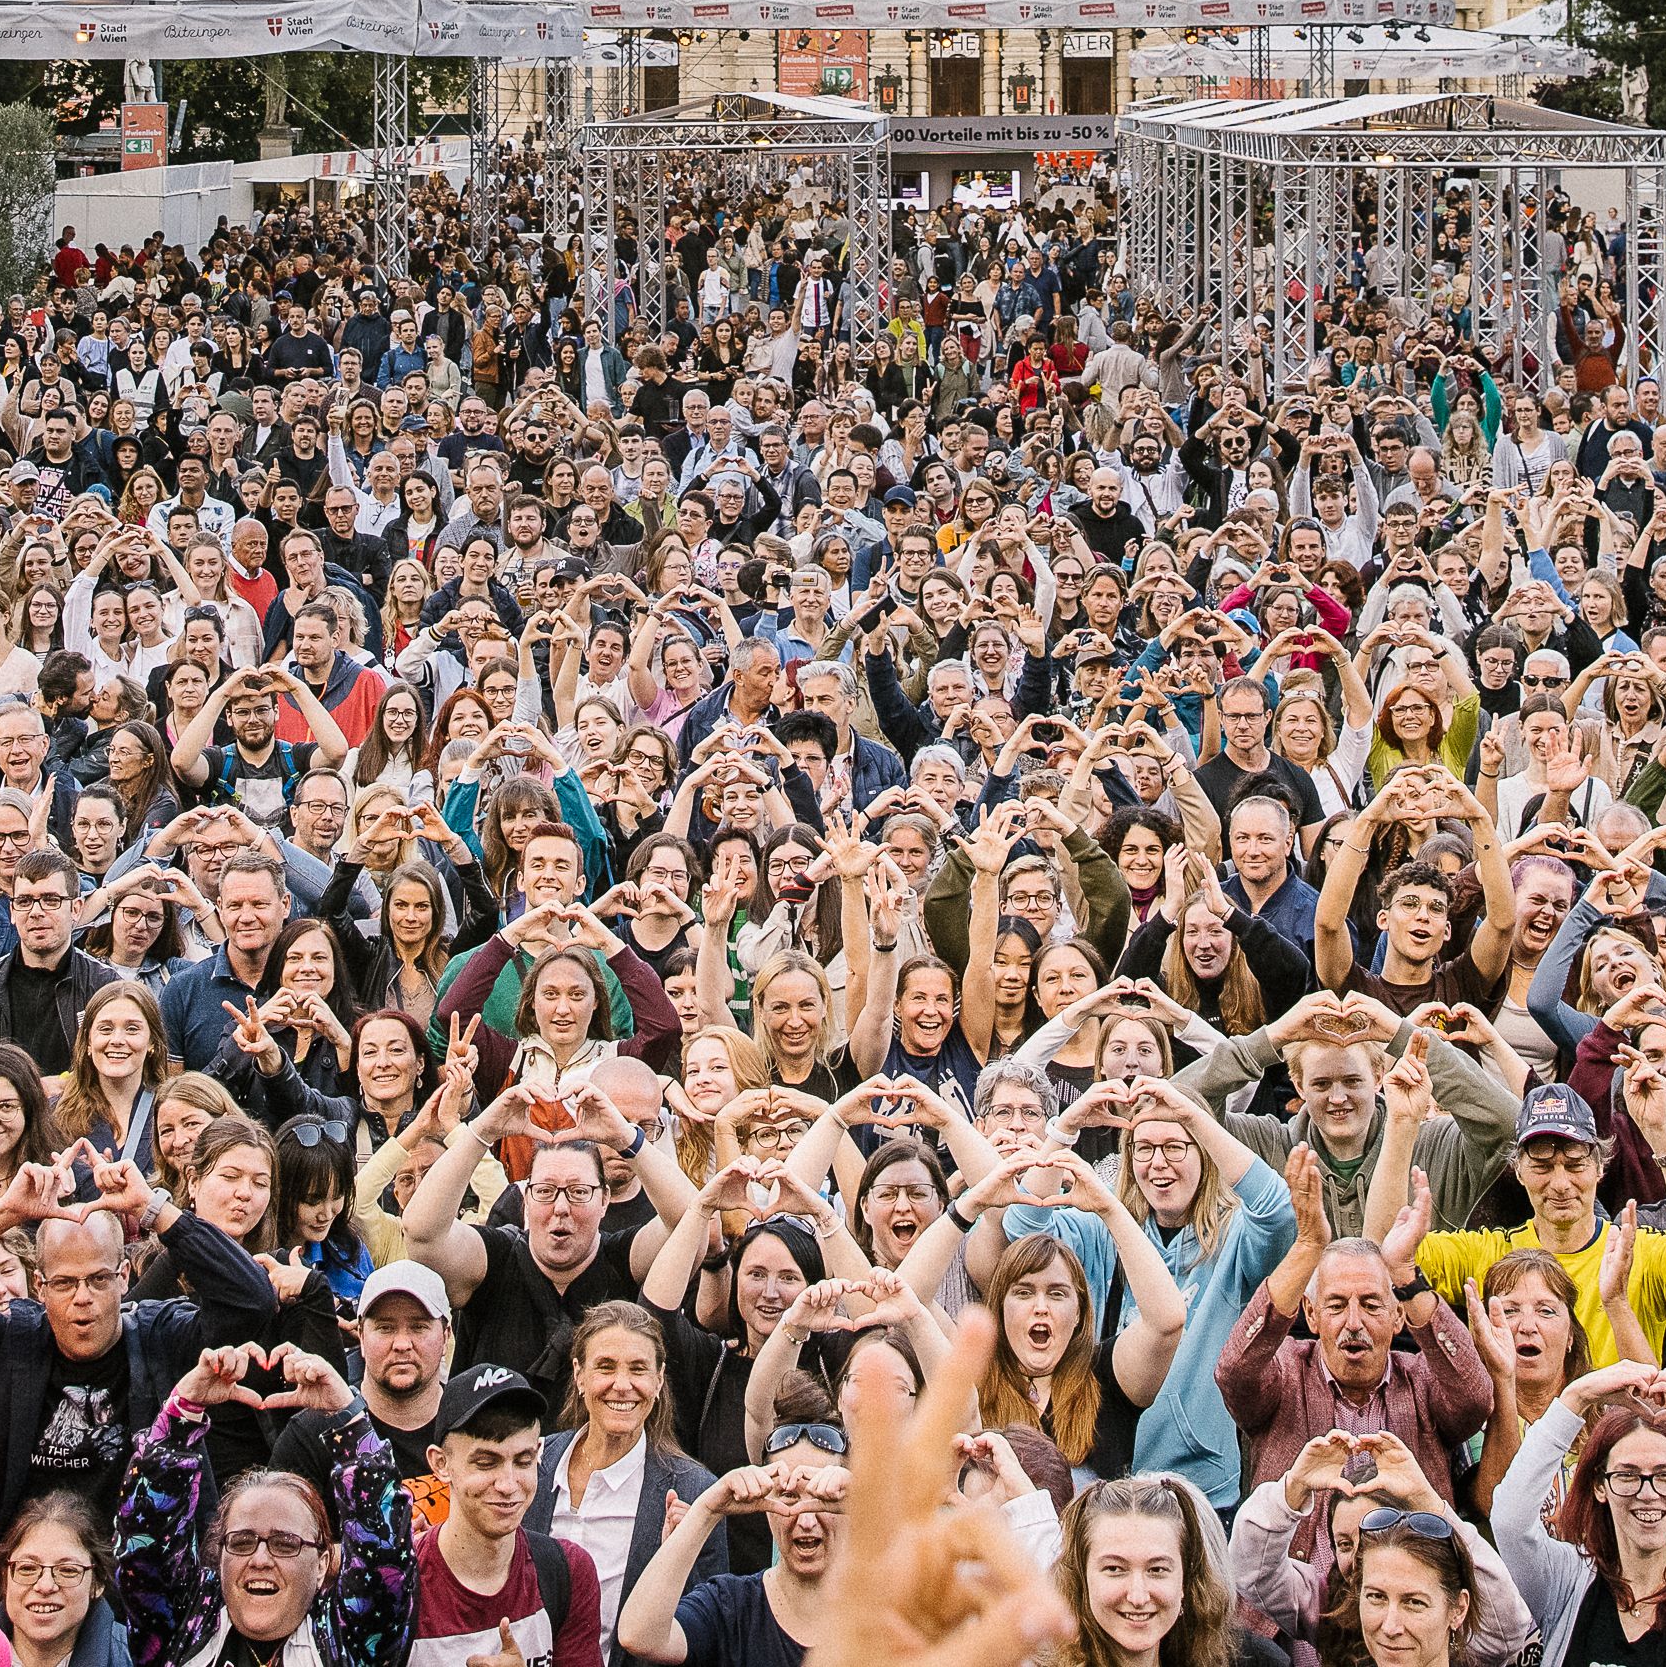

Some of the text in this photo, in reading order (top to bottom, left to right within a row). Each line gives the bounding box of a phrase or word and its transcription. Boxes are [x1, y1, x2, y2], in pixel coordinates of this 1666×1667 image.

[287, 16, 313, 26] Stadt
[347, 16, 405, 37] Bitzinger
[441, 22, 458, 30] Stadt
[100, 24, 127, 33] Stadt
[164, 25, 233, 42] Bitzinger
[287, 27, 314, 36] Wien
[100, 34, 127, 43] Wien
[1064, 36, 1111, 50] ATER
[919, 128, 982, 142] Vorteile
[986, 127, 1013, 141] mit
[1017, 127, 1040, 140] bis
[1043, 130, 1061, 140] zu
[1065, 126, 1092, 140] -50
[1096, 126, 1109, 139] %
[473, 1367, 513, 1392] MC
[48, 1445, 69, 1456] THE
[30, 1453, 90, 1468] WITCHER
